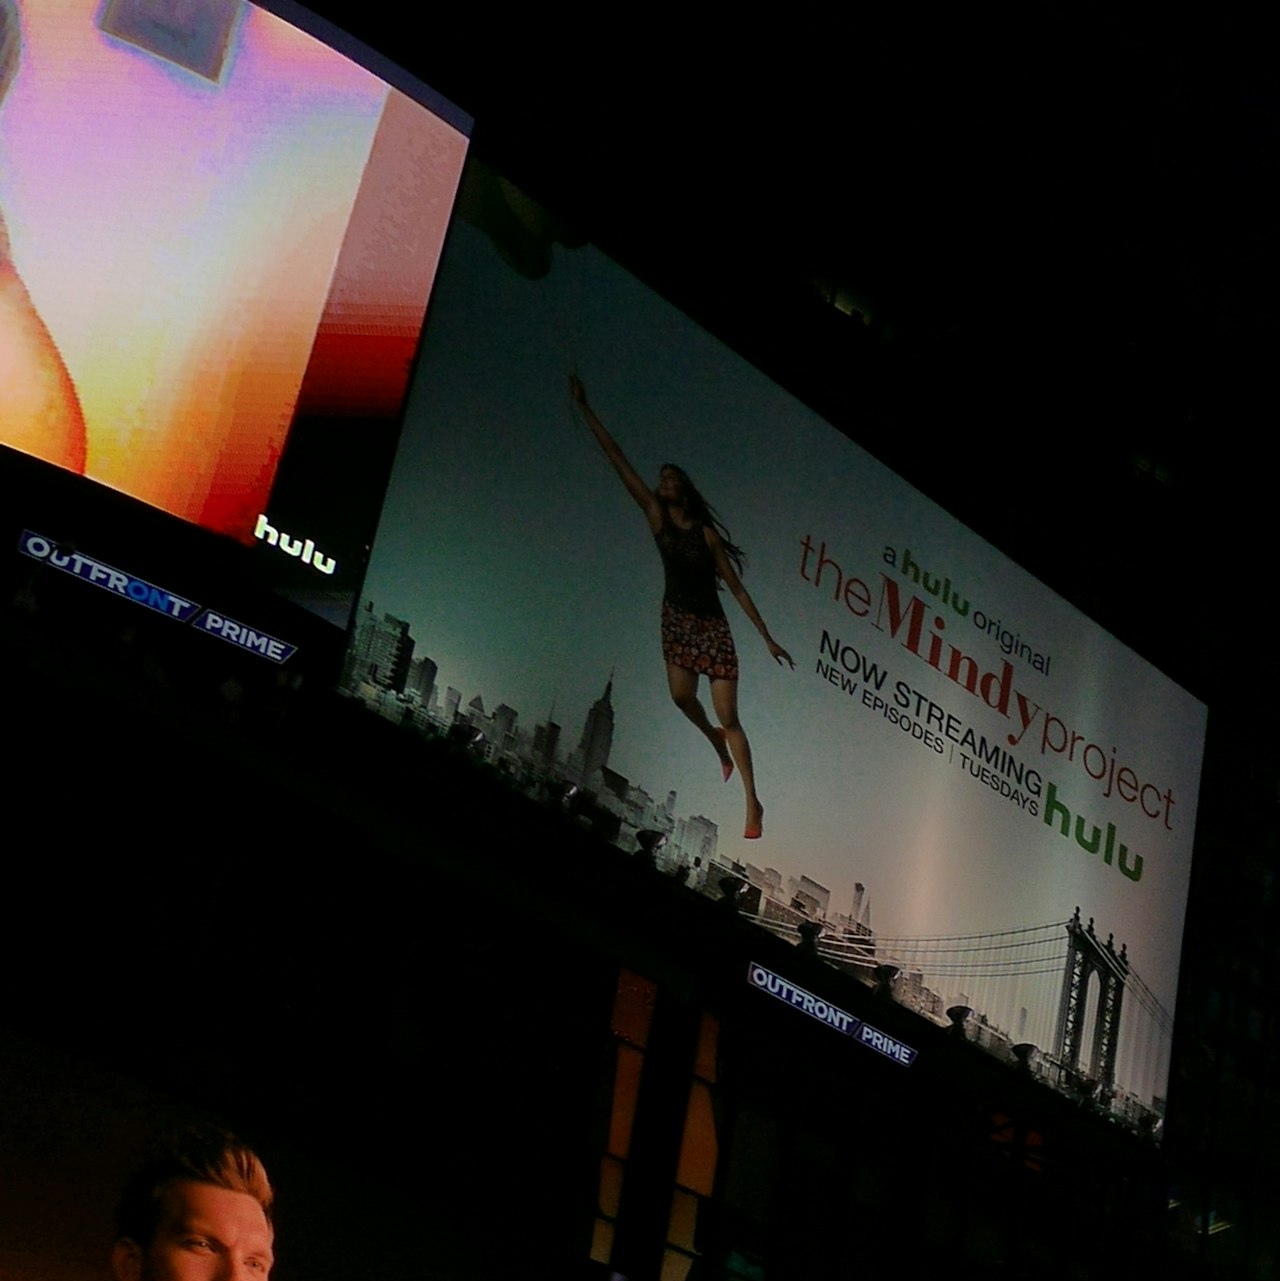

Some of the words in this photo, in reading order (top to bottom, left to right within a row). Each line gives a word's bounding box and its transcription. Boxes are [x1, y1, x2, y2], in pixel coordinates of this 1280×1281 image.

[25, 535, 191, 620] OUTFRONT
[204, 614, 285, 661] PRIME
[254, 513, 336, 575] hulu
[883, 546, 896, 567] a
[901, 549, 970, 617] hulu
[974, 611, 1051, 676] original
[800, 534, 871, 618] the
[871, 572, 1040, 745] Mindy
[1042, 712, 1175, 830] project
[816, 659, 856, 696] NEW
[862, 689, 944, 754] EPISODES
[960, 754, 1039, 816] TUESDAYS
[820, 630, 887, 690] NOW
[893, 681, 1042, 797] STREAMING
[1043, 781, 1143, 882] hulu
[752, 969, 853, 1031] OUTFRONT
[862, 1026, 910, 1064] PRIME
